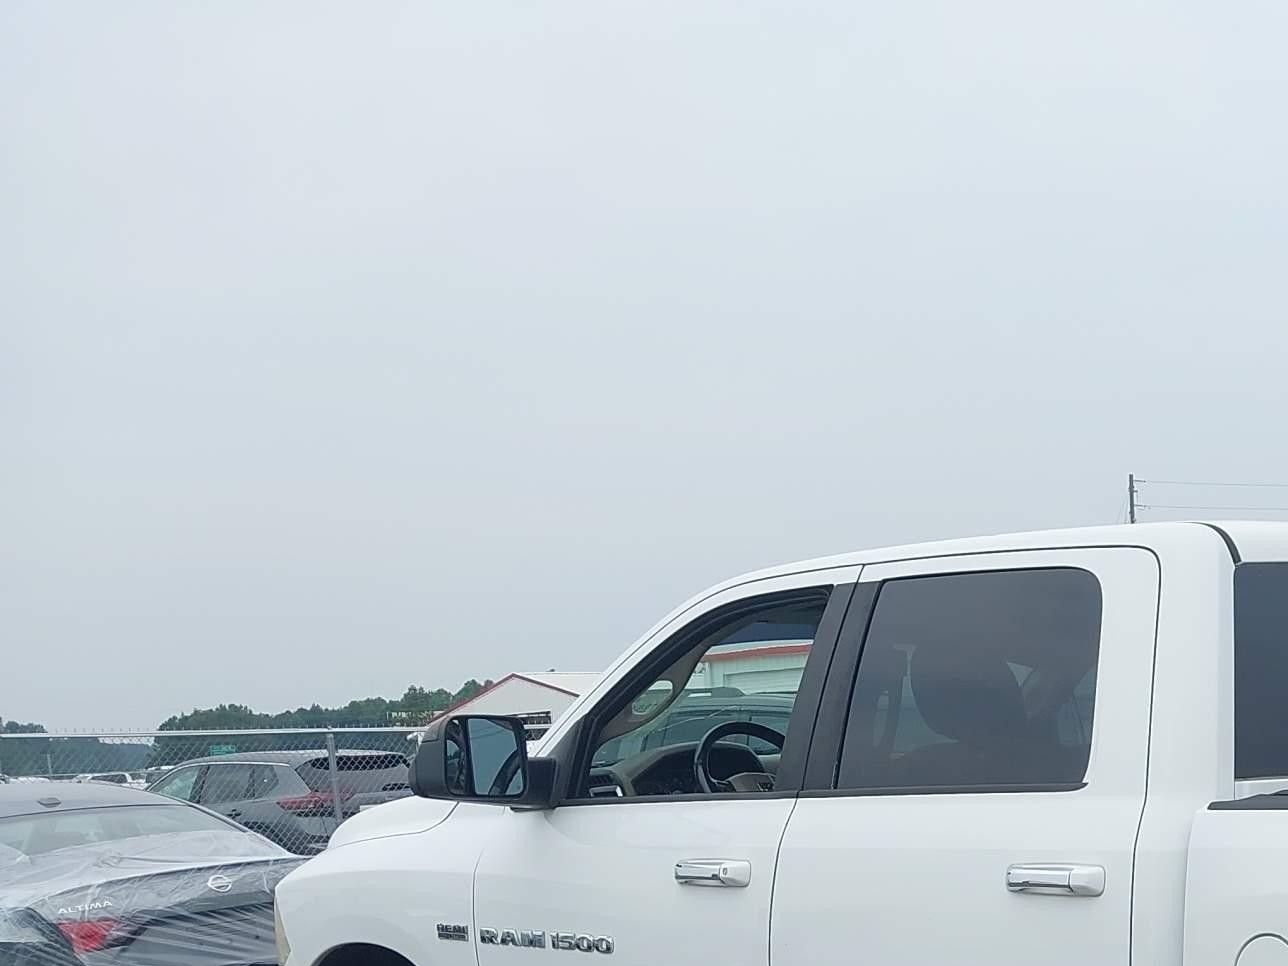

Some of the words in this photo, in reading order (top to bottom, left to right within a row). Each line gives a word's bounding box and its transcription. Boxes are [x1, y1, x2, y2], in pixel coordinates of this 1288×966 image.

[57, 900, 113, 915] ALTIMA
[479, 927, 546, 949] RAM
[549, 931, 615, 955] 1500
